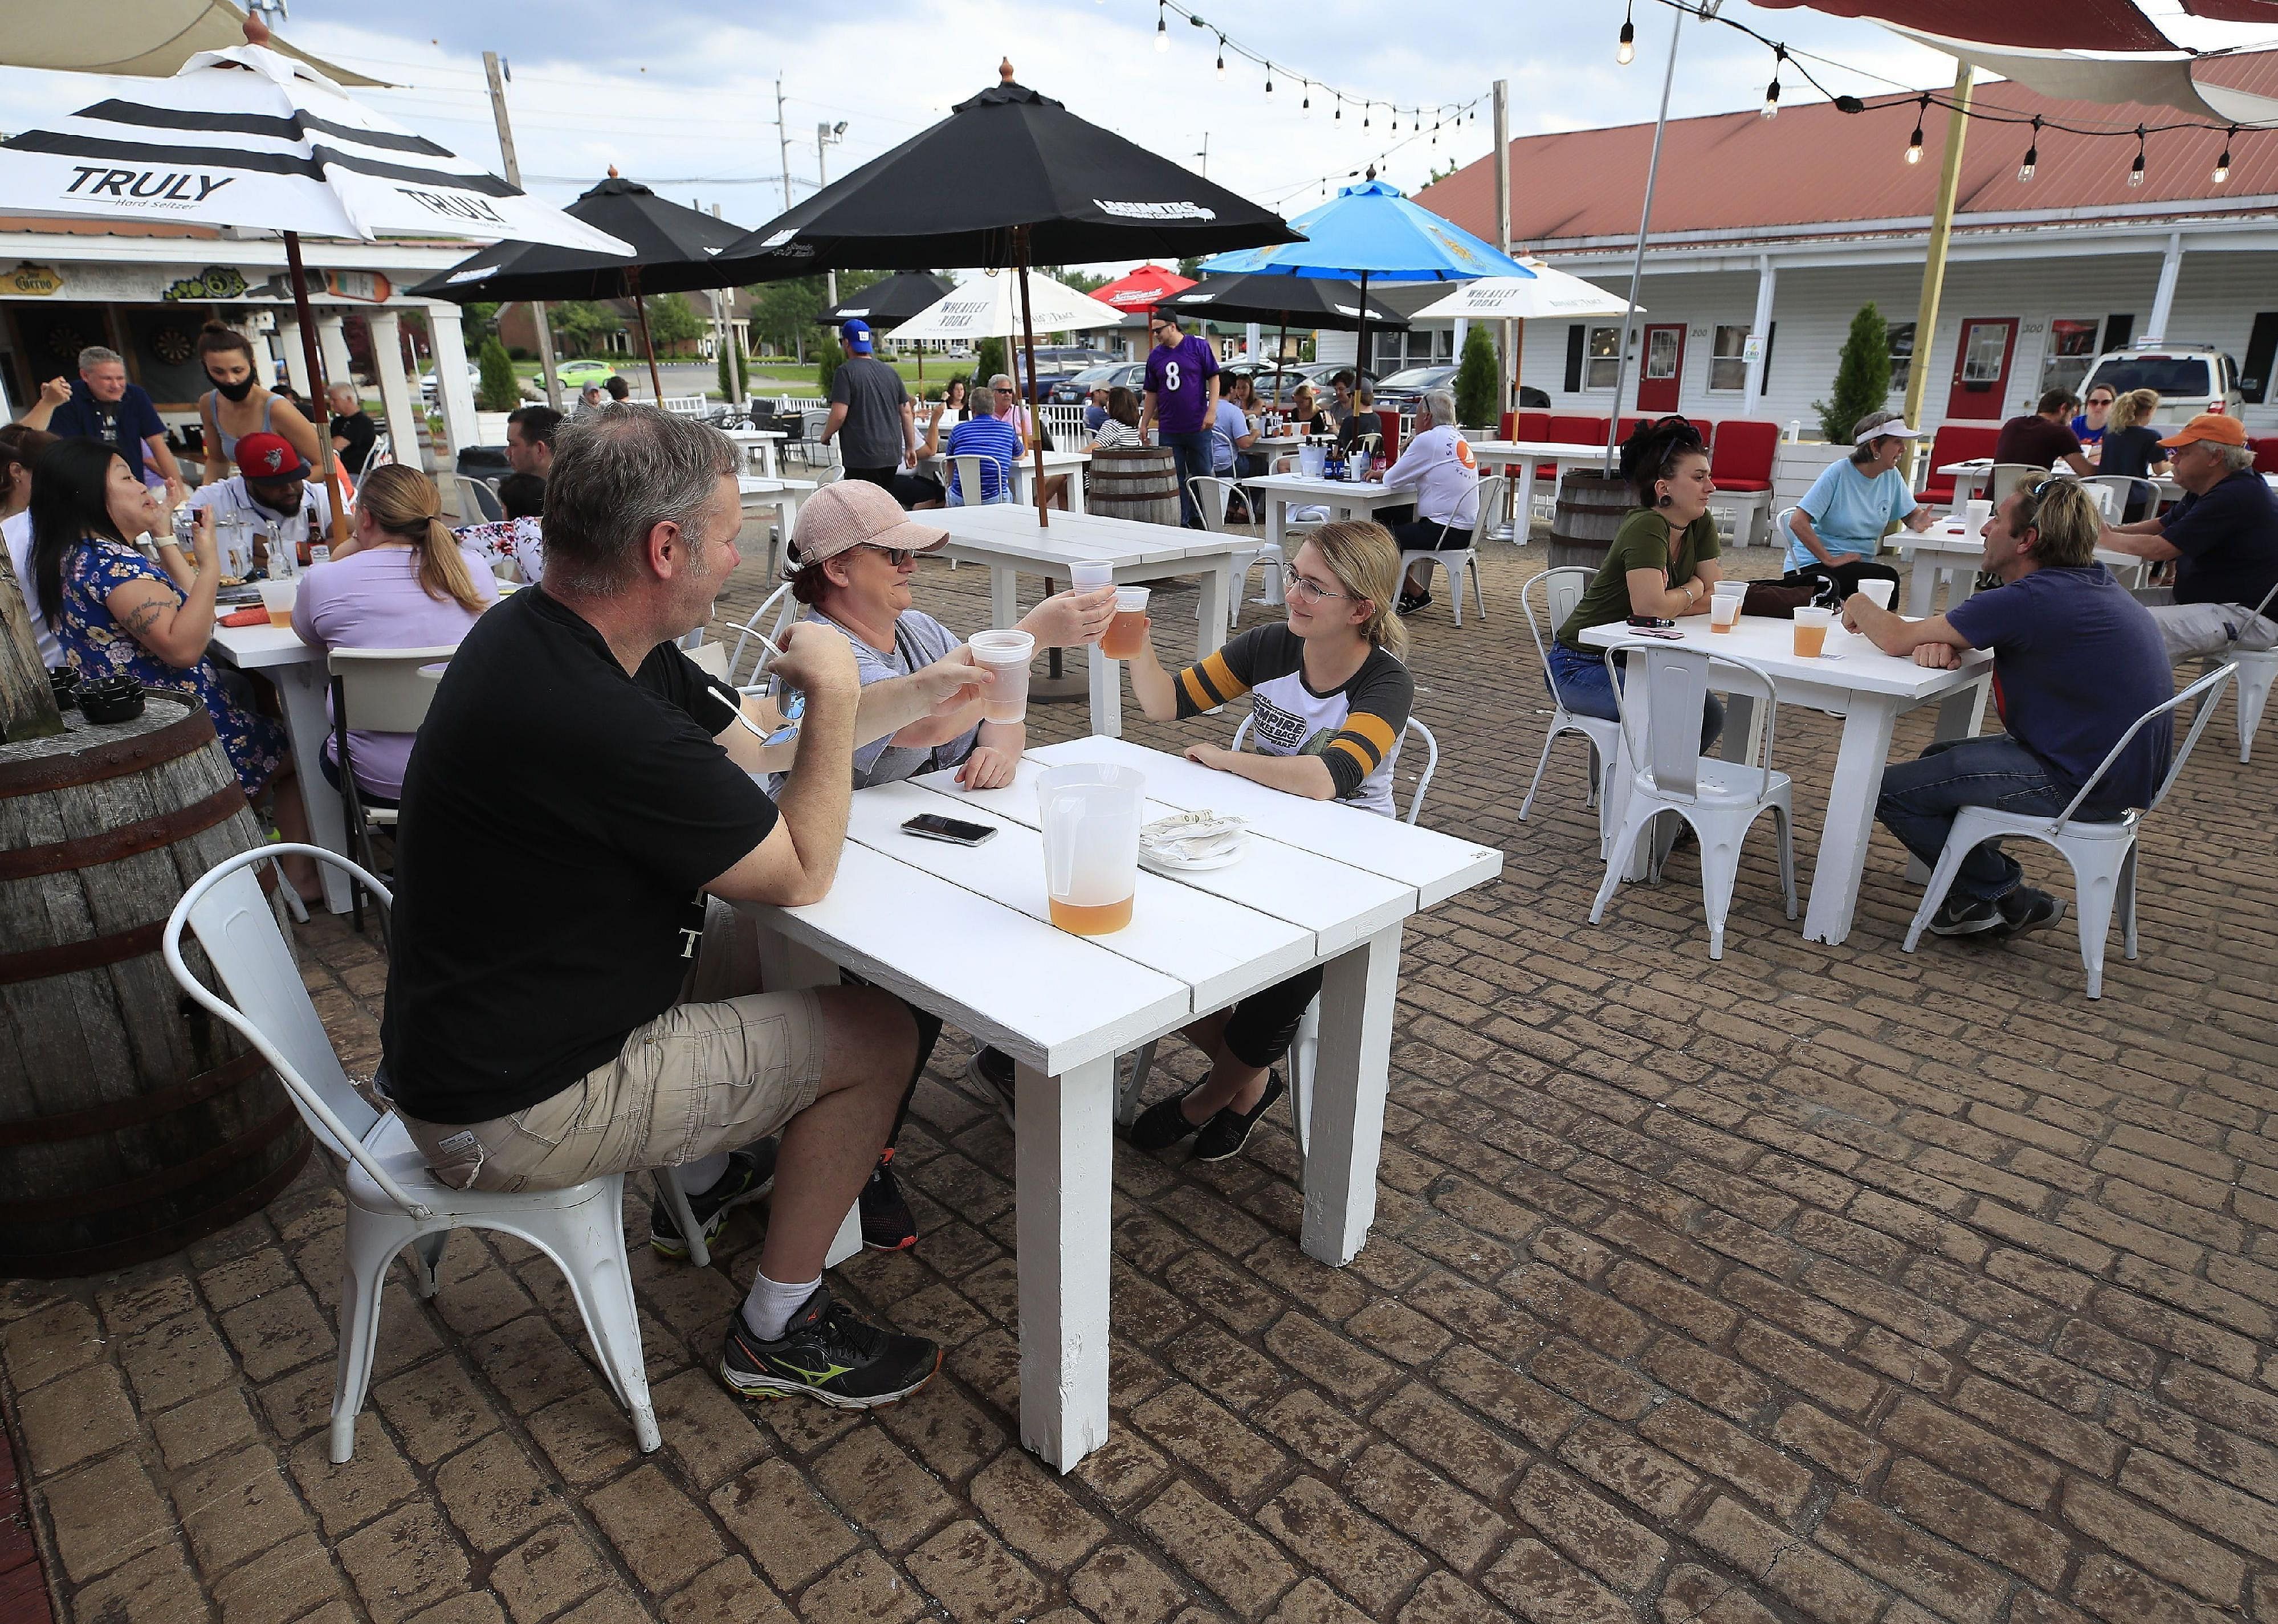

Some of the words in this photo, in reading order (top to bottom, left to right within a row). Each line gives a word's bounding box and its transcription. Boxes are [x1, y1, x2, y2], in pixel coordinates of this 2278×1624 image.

[66, 166, 236, 201] TRULY
[150, 201, 201, 210] Seltzer
[393, 187, 507, 223] TRULY
[1467, 289, 1519, 298] WHEATLEY
[940, 301, 989, 313] WHEATLEY
[1467, 299, 1503, 307] VODKA
[939, 315, 972, 327] VODKA
[1692, 328, 1708, 337] 200
[1165, 361, 1180, 391] 8
[1275, 729, 1299, 741] BACK
[679, 928, 703, 958] T
